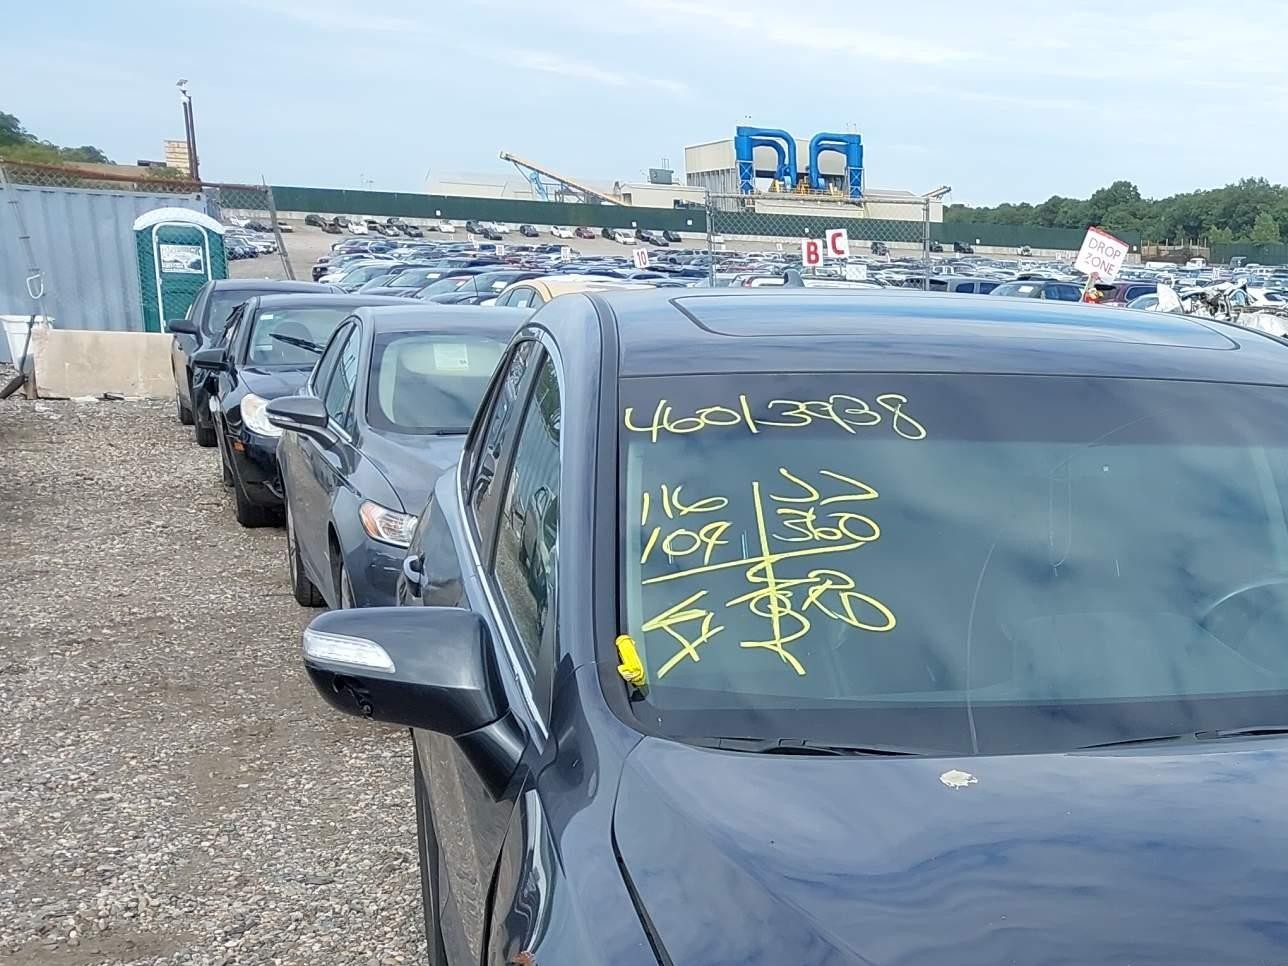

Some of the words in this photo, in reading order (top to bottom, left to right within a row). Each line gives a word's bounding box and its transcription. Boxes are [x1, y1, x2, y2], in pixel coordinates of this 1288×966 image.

[806, 241, 820, 264] B
[831, 232, 845, 255] C
[1088, 237, 1121, 259] DROP
[636, 250, 647, 266] 10
[1083, 252, 1116, 276] ZONE
